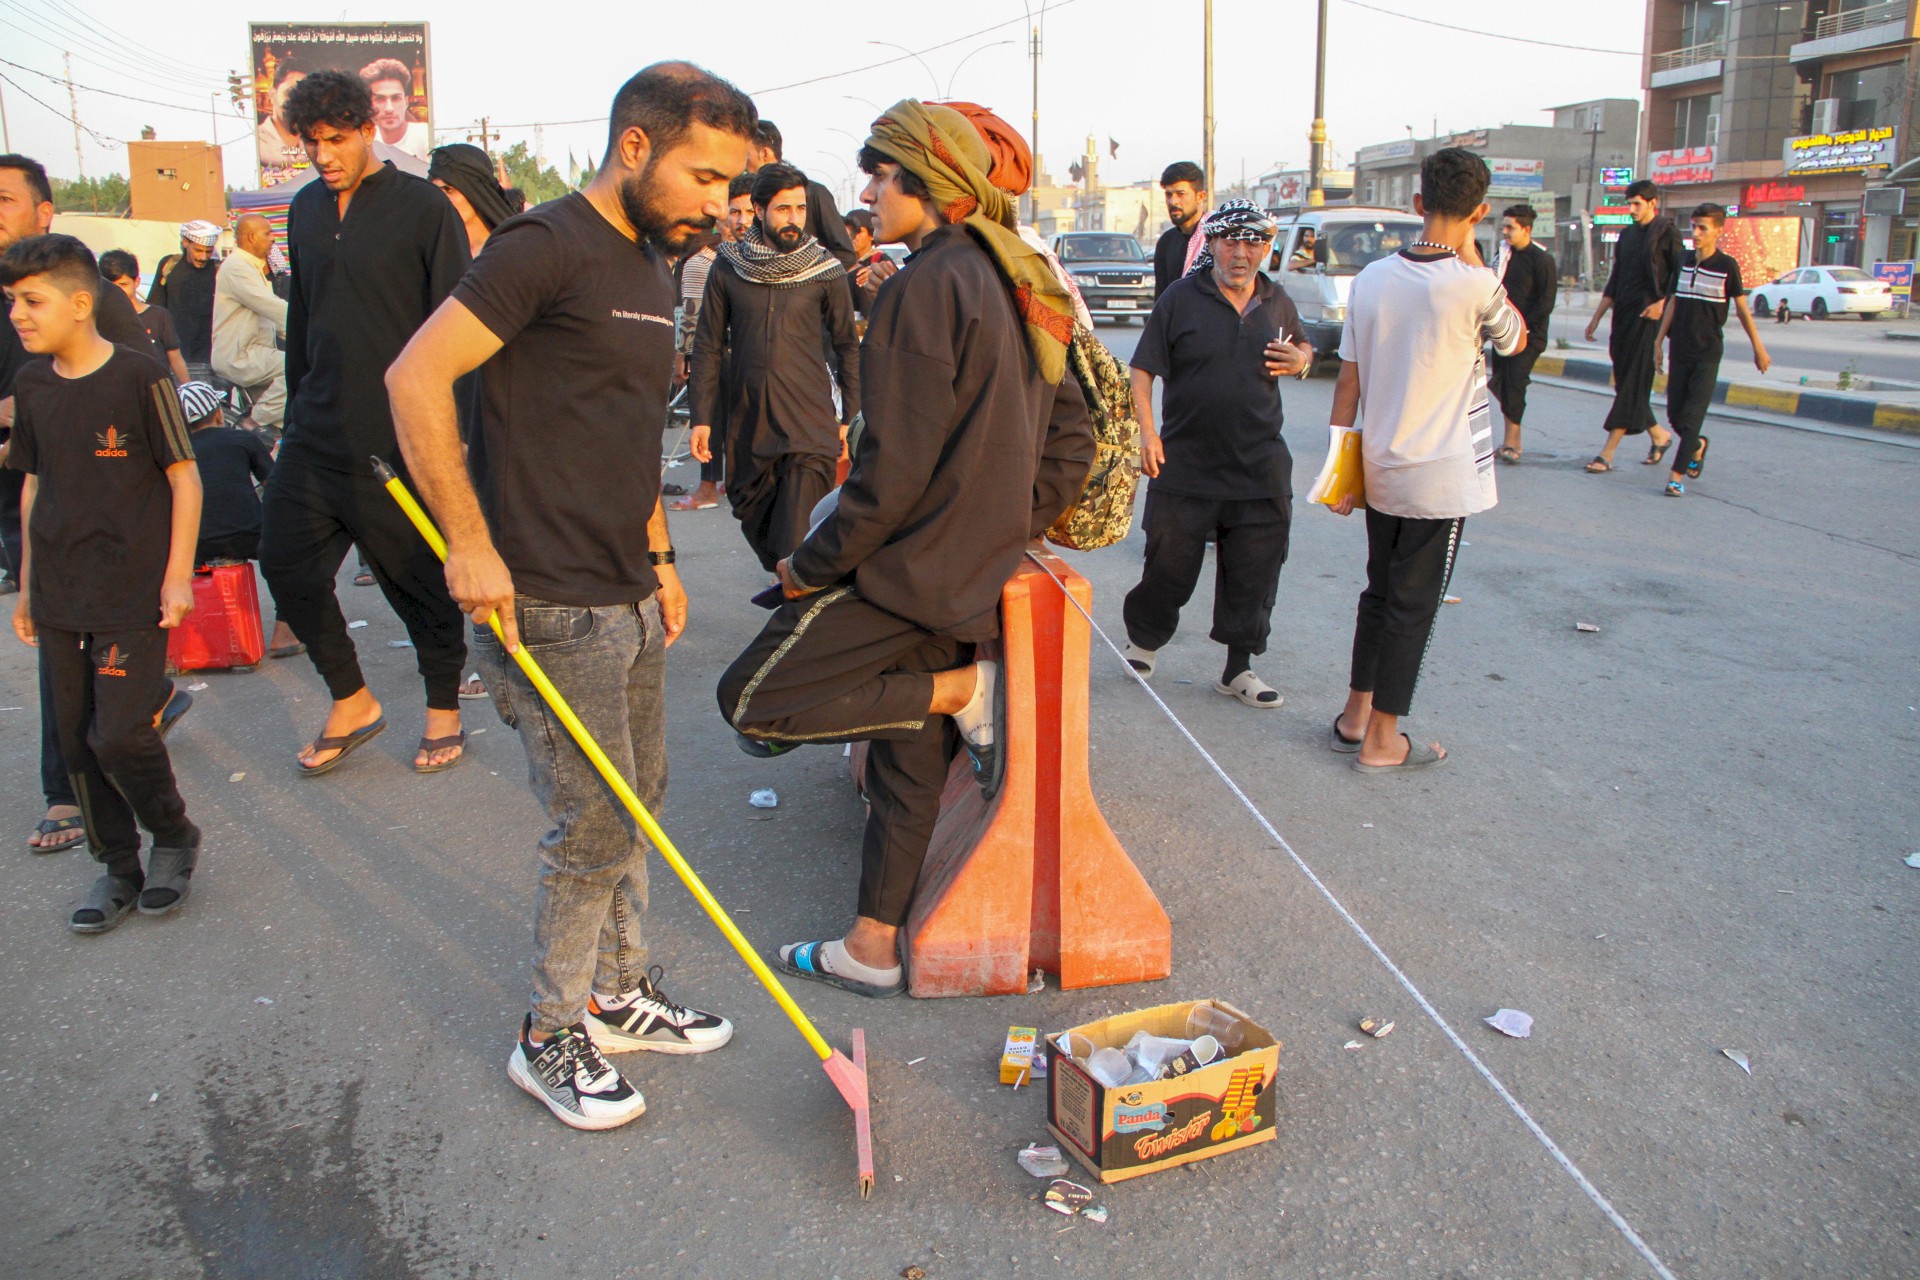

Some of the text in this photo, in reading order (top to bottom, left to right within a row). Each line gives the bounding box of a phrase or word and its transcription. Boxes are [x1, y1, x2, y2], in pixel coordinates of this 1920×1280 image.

[95, 448, 128, 457] adidas
[98, 666, 127, 677] adidas
[1117, 1110, 1160, 1127] Panda
